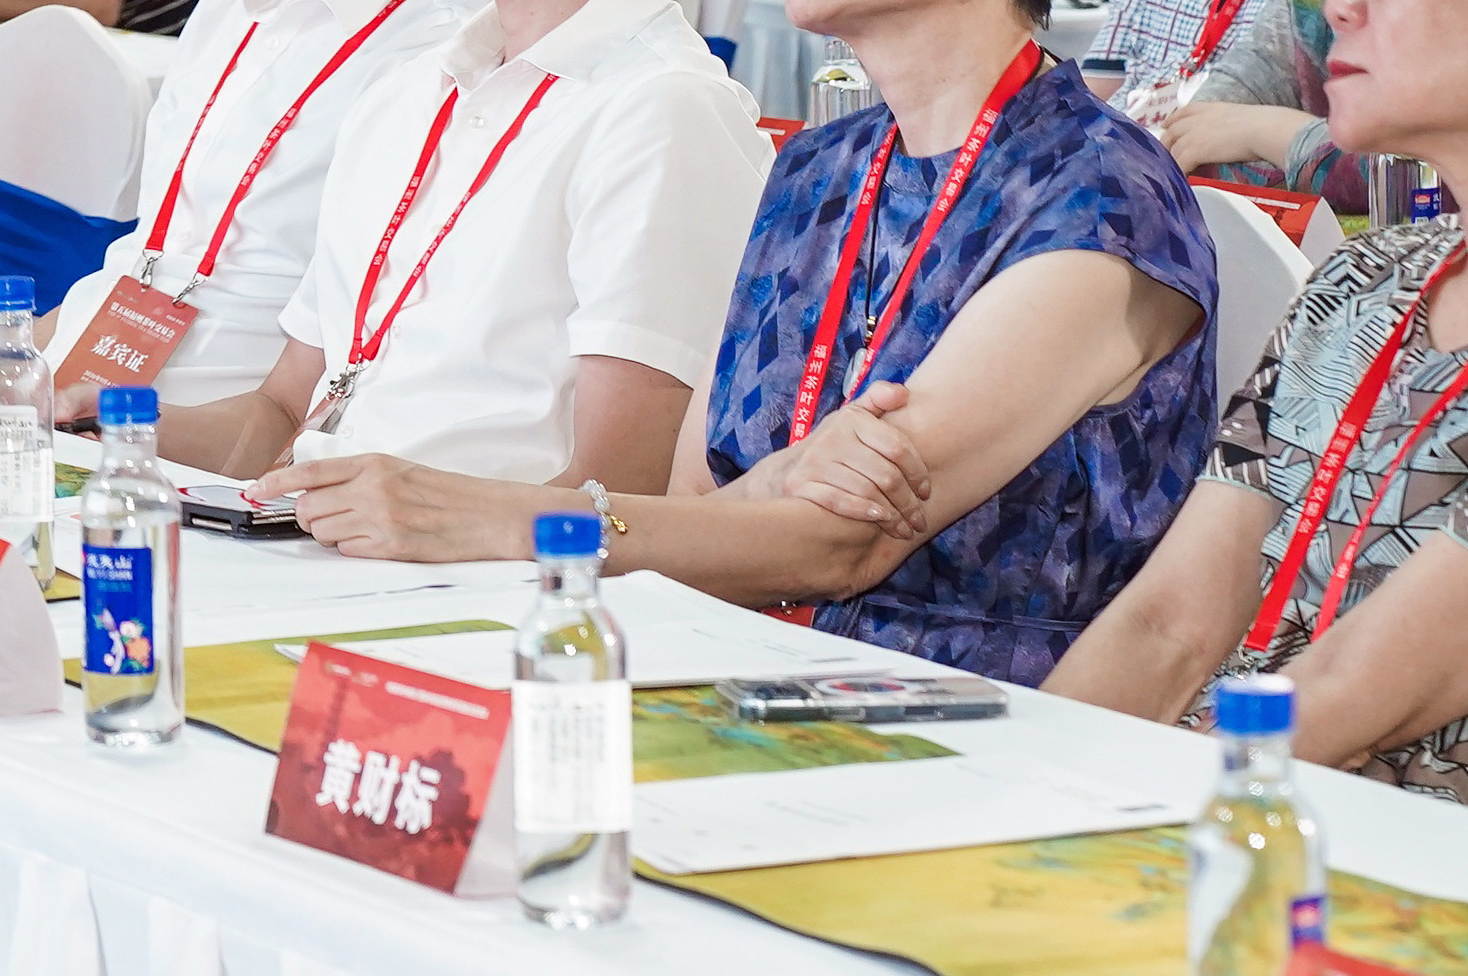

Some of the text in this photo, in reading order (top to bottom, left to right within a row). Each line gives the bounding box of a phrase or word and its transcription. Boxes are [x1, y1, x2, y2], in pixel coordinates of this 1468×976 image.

[90, 335, 149, 373] 嘉宾证
[315, 738, 442, 835] 黄财标
